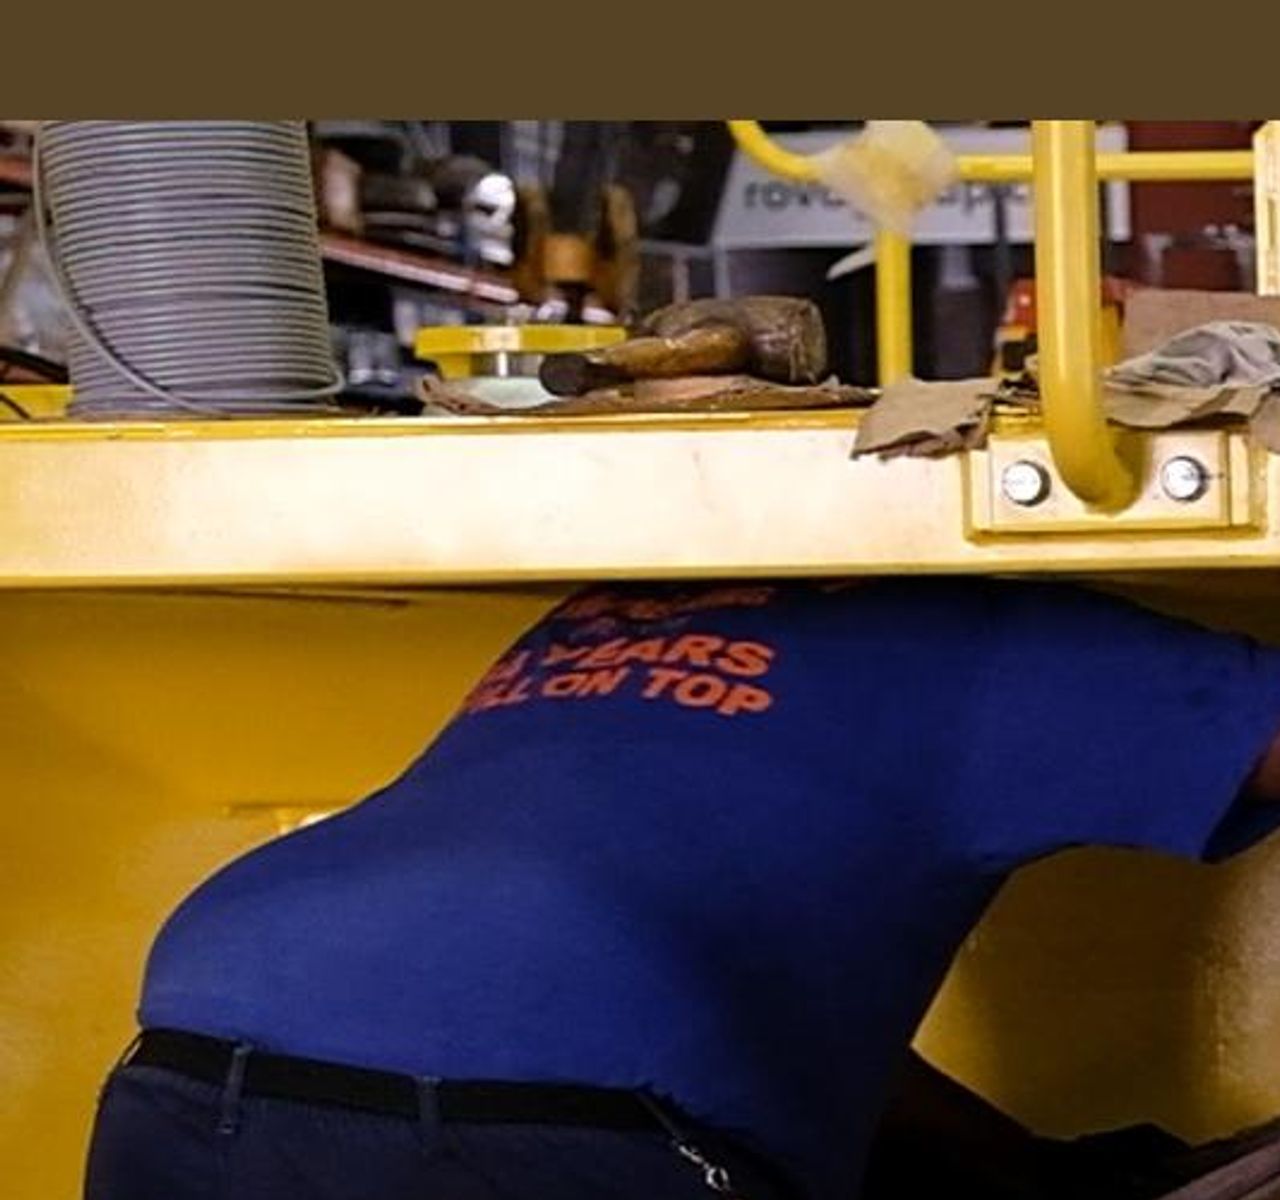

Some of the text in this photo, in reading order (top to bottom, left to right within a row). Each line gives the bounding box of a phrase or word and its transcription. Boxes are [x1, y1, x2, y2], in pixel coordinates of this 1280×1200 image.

[542, 634, 775, 677] YEARS
[542, 667, 631, 698] ON
[641, 667, 773, 715] TOP
